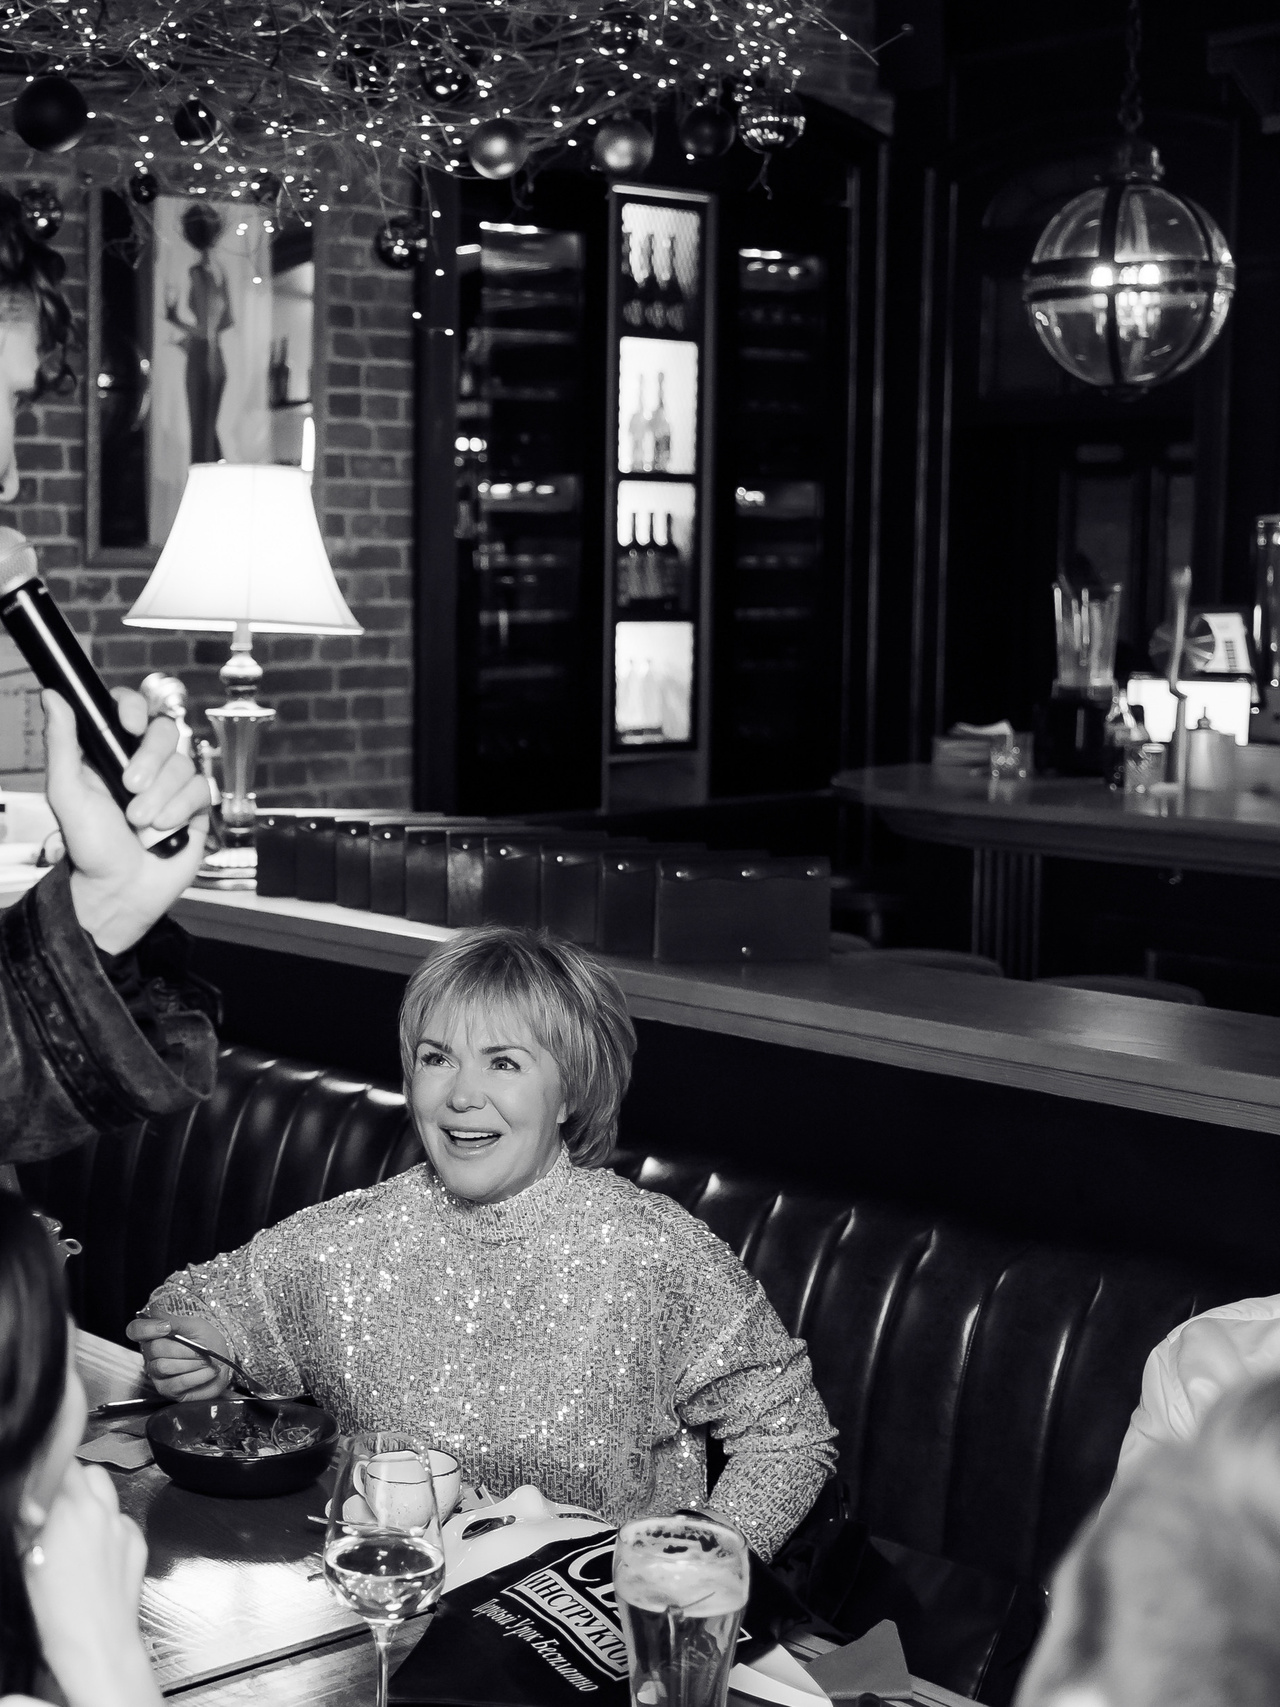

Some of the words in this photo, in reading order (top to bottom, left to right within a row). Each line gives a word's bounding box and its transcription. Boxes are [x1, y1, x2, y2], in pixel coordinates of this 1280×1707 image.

[503, 1618, 544, 1642] Урок
[531, 1639, 599, 1692] Бесплатно
[523, 1574, 628, 1667] ИНСТРУКТО
